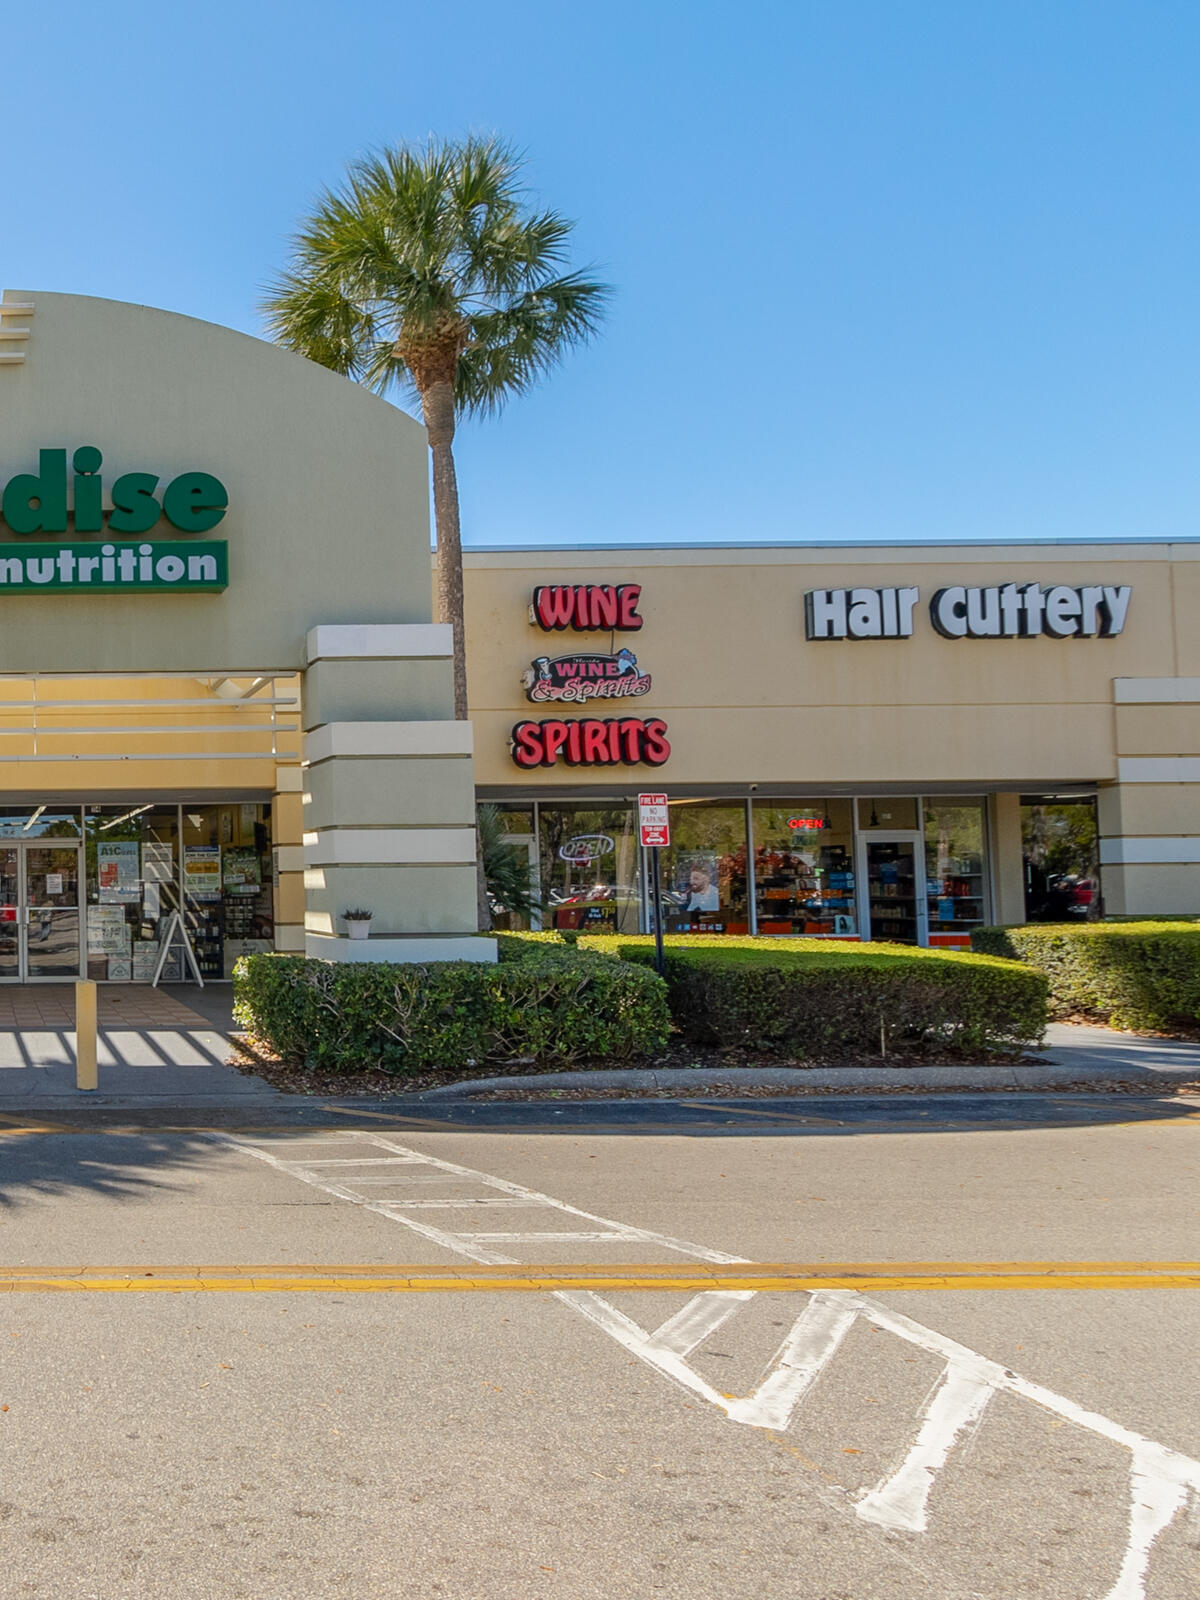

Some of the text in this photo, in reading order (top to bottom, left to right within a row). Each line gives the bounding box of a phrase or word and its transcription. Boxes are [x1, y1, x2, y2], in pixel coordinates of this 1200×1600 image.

[537, 584, 644, 629] WINE
[555, 662, 621, 677] WINE
[531, 675, 651, 703] & Spirits
[517, 719, 671, 765] SPIRITS
[640, 797, 665, 805] FIRE LANE
[649, 807, 657, 815] NO
[789, 819, 823, 829] OPEN
[563, 840, 608, 856] OPEN
